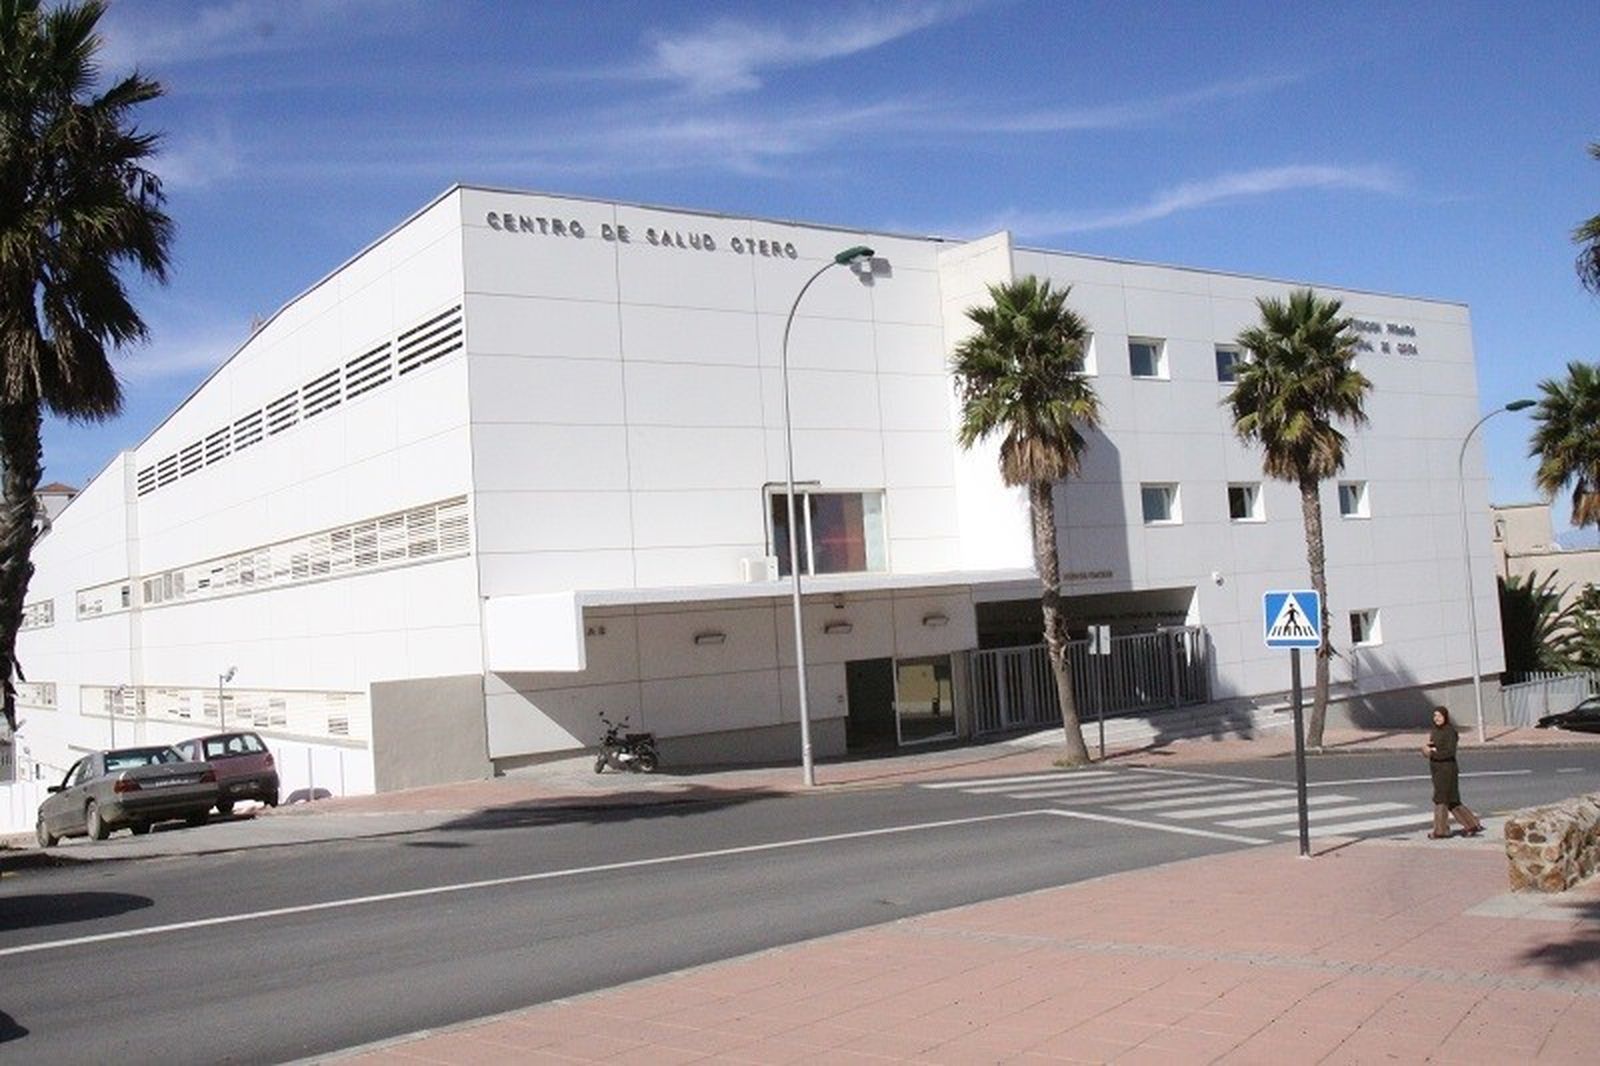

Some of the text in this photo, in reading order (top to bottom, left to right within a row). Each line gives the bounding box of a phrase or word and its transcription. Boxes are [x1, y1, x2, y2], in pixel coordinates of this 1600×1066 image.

[486, 210, 799, 261] CENTRO DE SALUD OTERO
